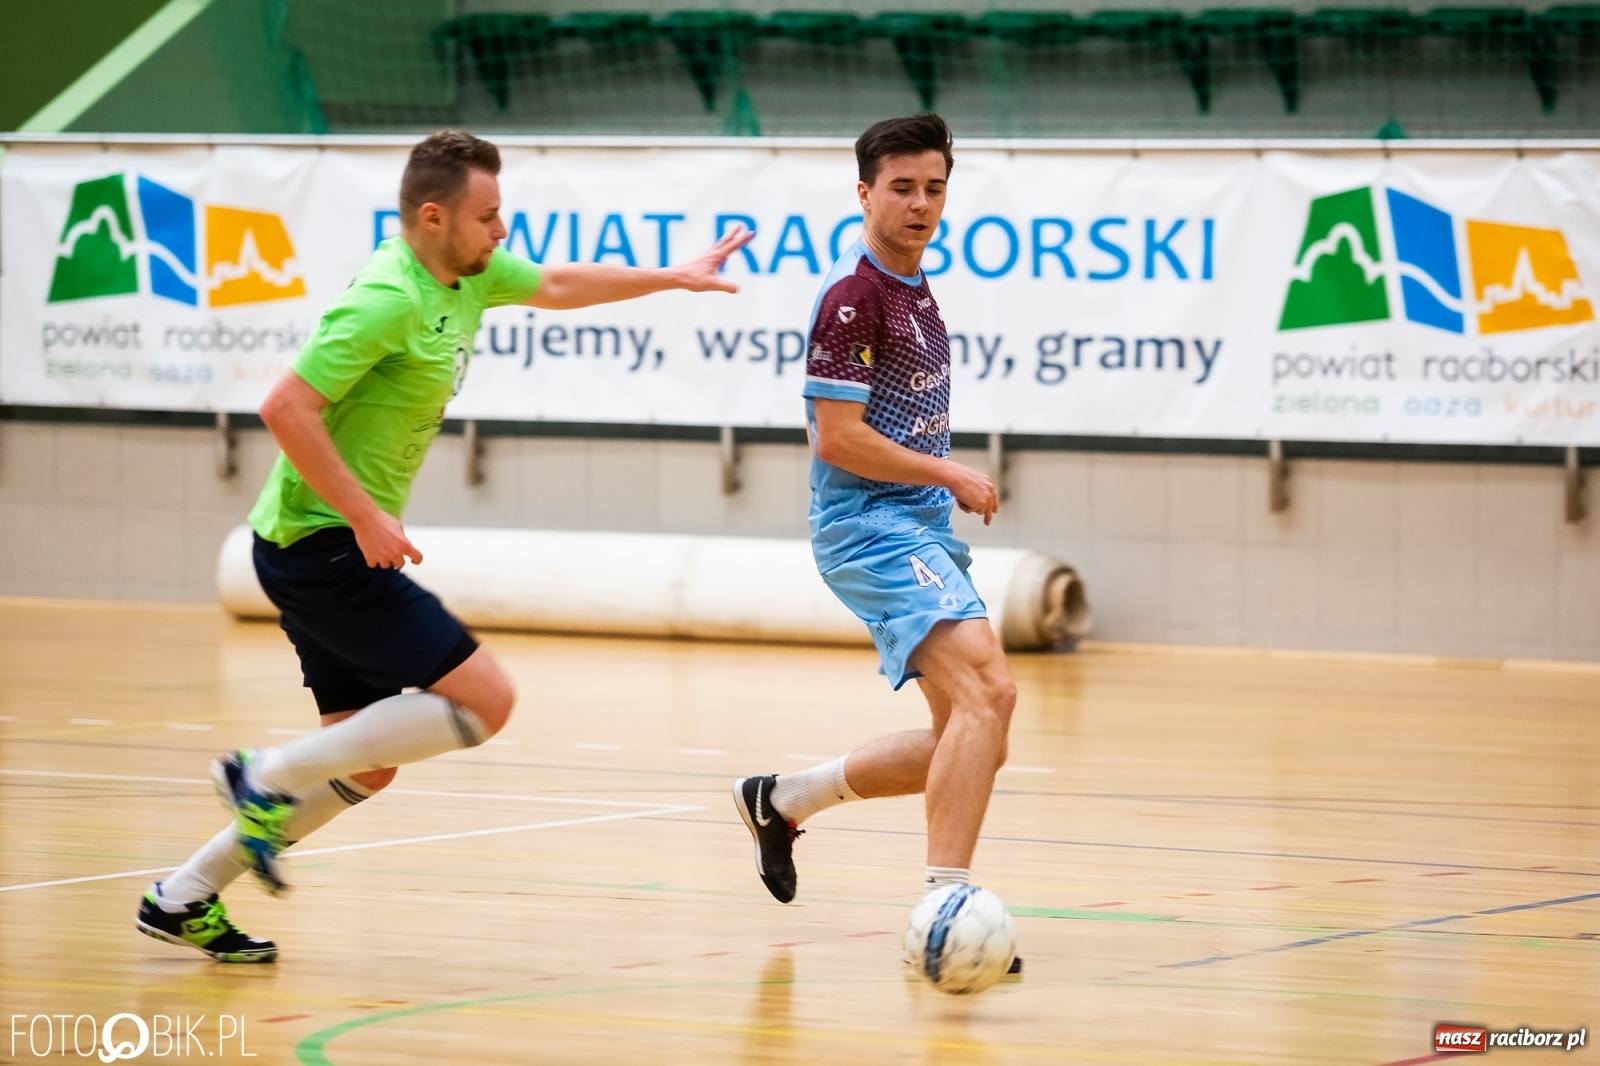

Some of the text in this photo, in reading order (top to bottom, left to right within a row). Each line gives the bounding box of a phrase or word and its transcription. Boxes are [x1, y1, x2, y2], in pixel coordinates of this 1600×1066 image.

[374, 210, 1215, 282] PWIAT RACBORSKI
[43, 317, 142, 353] powiat
[474, 311, 664, 372] ujemy,
[1035, 331, 1222, 386] gramy
[910, 363, 951, 392] Geo-P
[1272, 343, 1396, 387] powiat
[911, 412, 950, 437] AGR
[1404, 396, 1482, 418] oaza
[907, 553, 946, 590] 4
